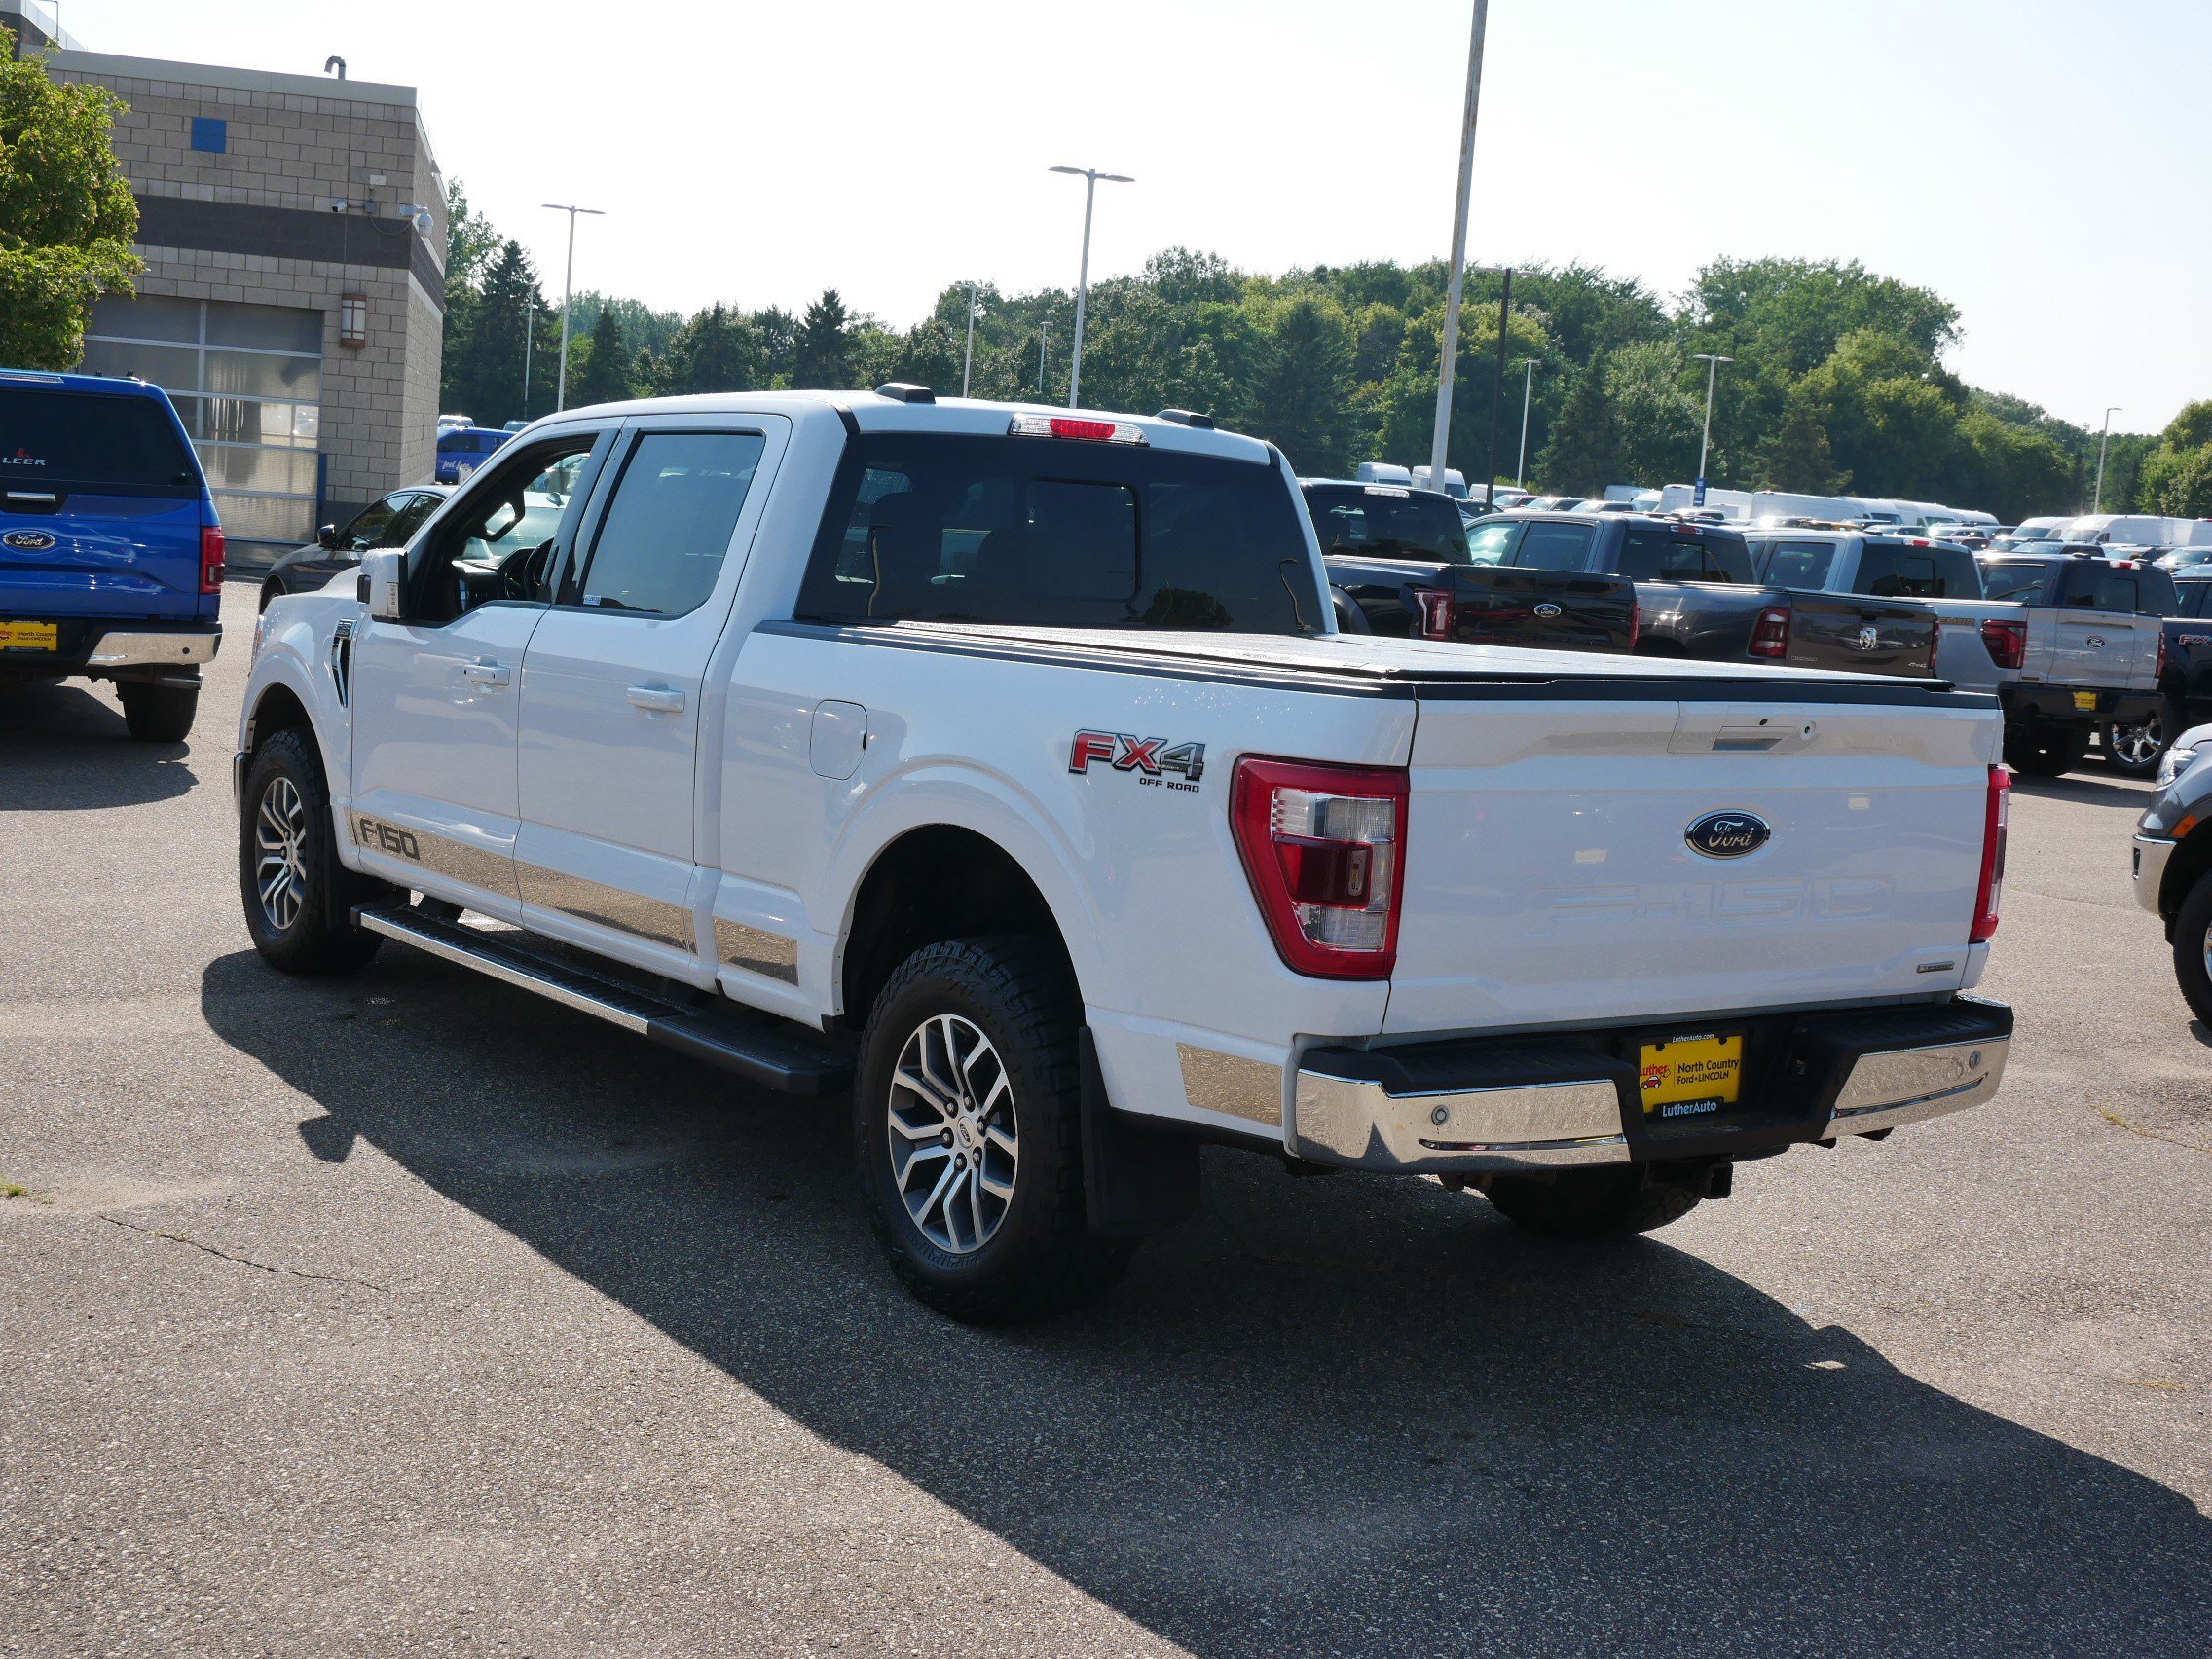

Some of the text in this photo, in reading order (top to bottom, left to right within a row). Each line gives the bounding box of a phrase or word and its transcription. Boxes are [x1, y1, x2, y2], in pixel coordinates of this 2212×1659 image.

[2, 457, 46, 466] LEER
[15, 533, 44, 546] Ford
[1068, 728, 1205, 782] FX4
[1139, 777, 1200, 793] OFF ROAD
[359, 818, 421, 861] F150
[1708, 820, 1754, 847] Ford
[1672, 1034, 1714, 1043] LutherAuto.com
[1677, 1058, 1740, 1074] North Country
[1677, 1070, 1730, 1085] Ford LINCOLN
[1662, 1100, 1717, 1118] LutherAuto
